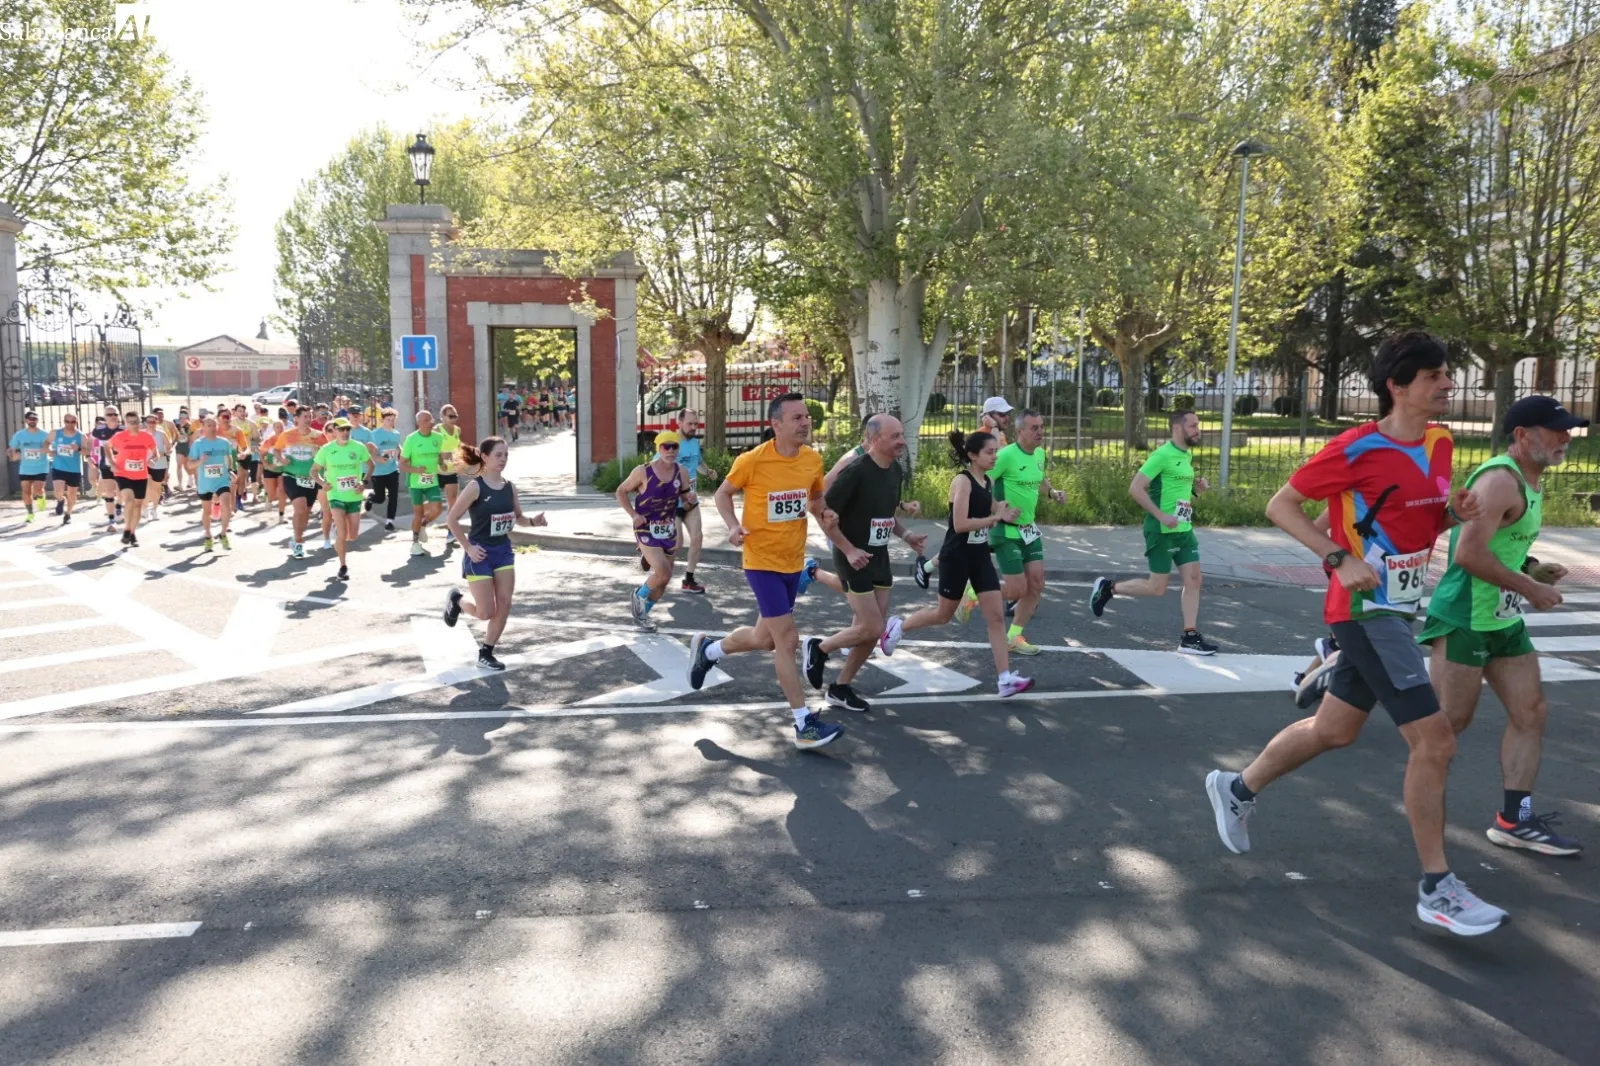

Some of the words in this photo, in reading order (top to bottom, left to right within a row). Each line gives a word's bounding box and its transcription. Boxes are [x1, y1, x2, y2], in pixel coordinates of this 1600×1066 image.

[341, 480, 356, 488] 915
[769, 491, 807, 501] bedunia
[775, 499, 801, 515] 853
[495, 519, 512, 531] 873
[654, 525, 671, 534] 854
